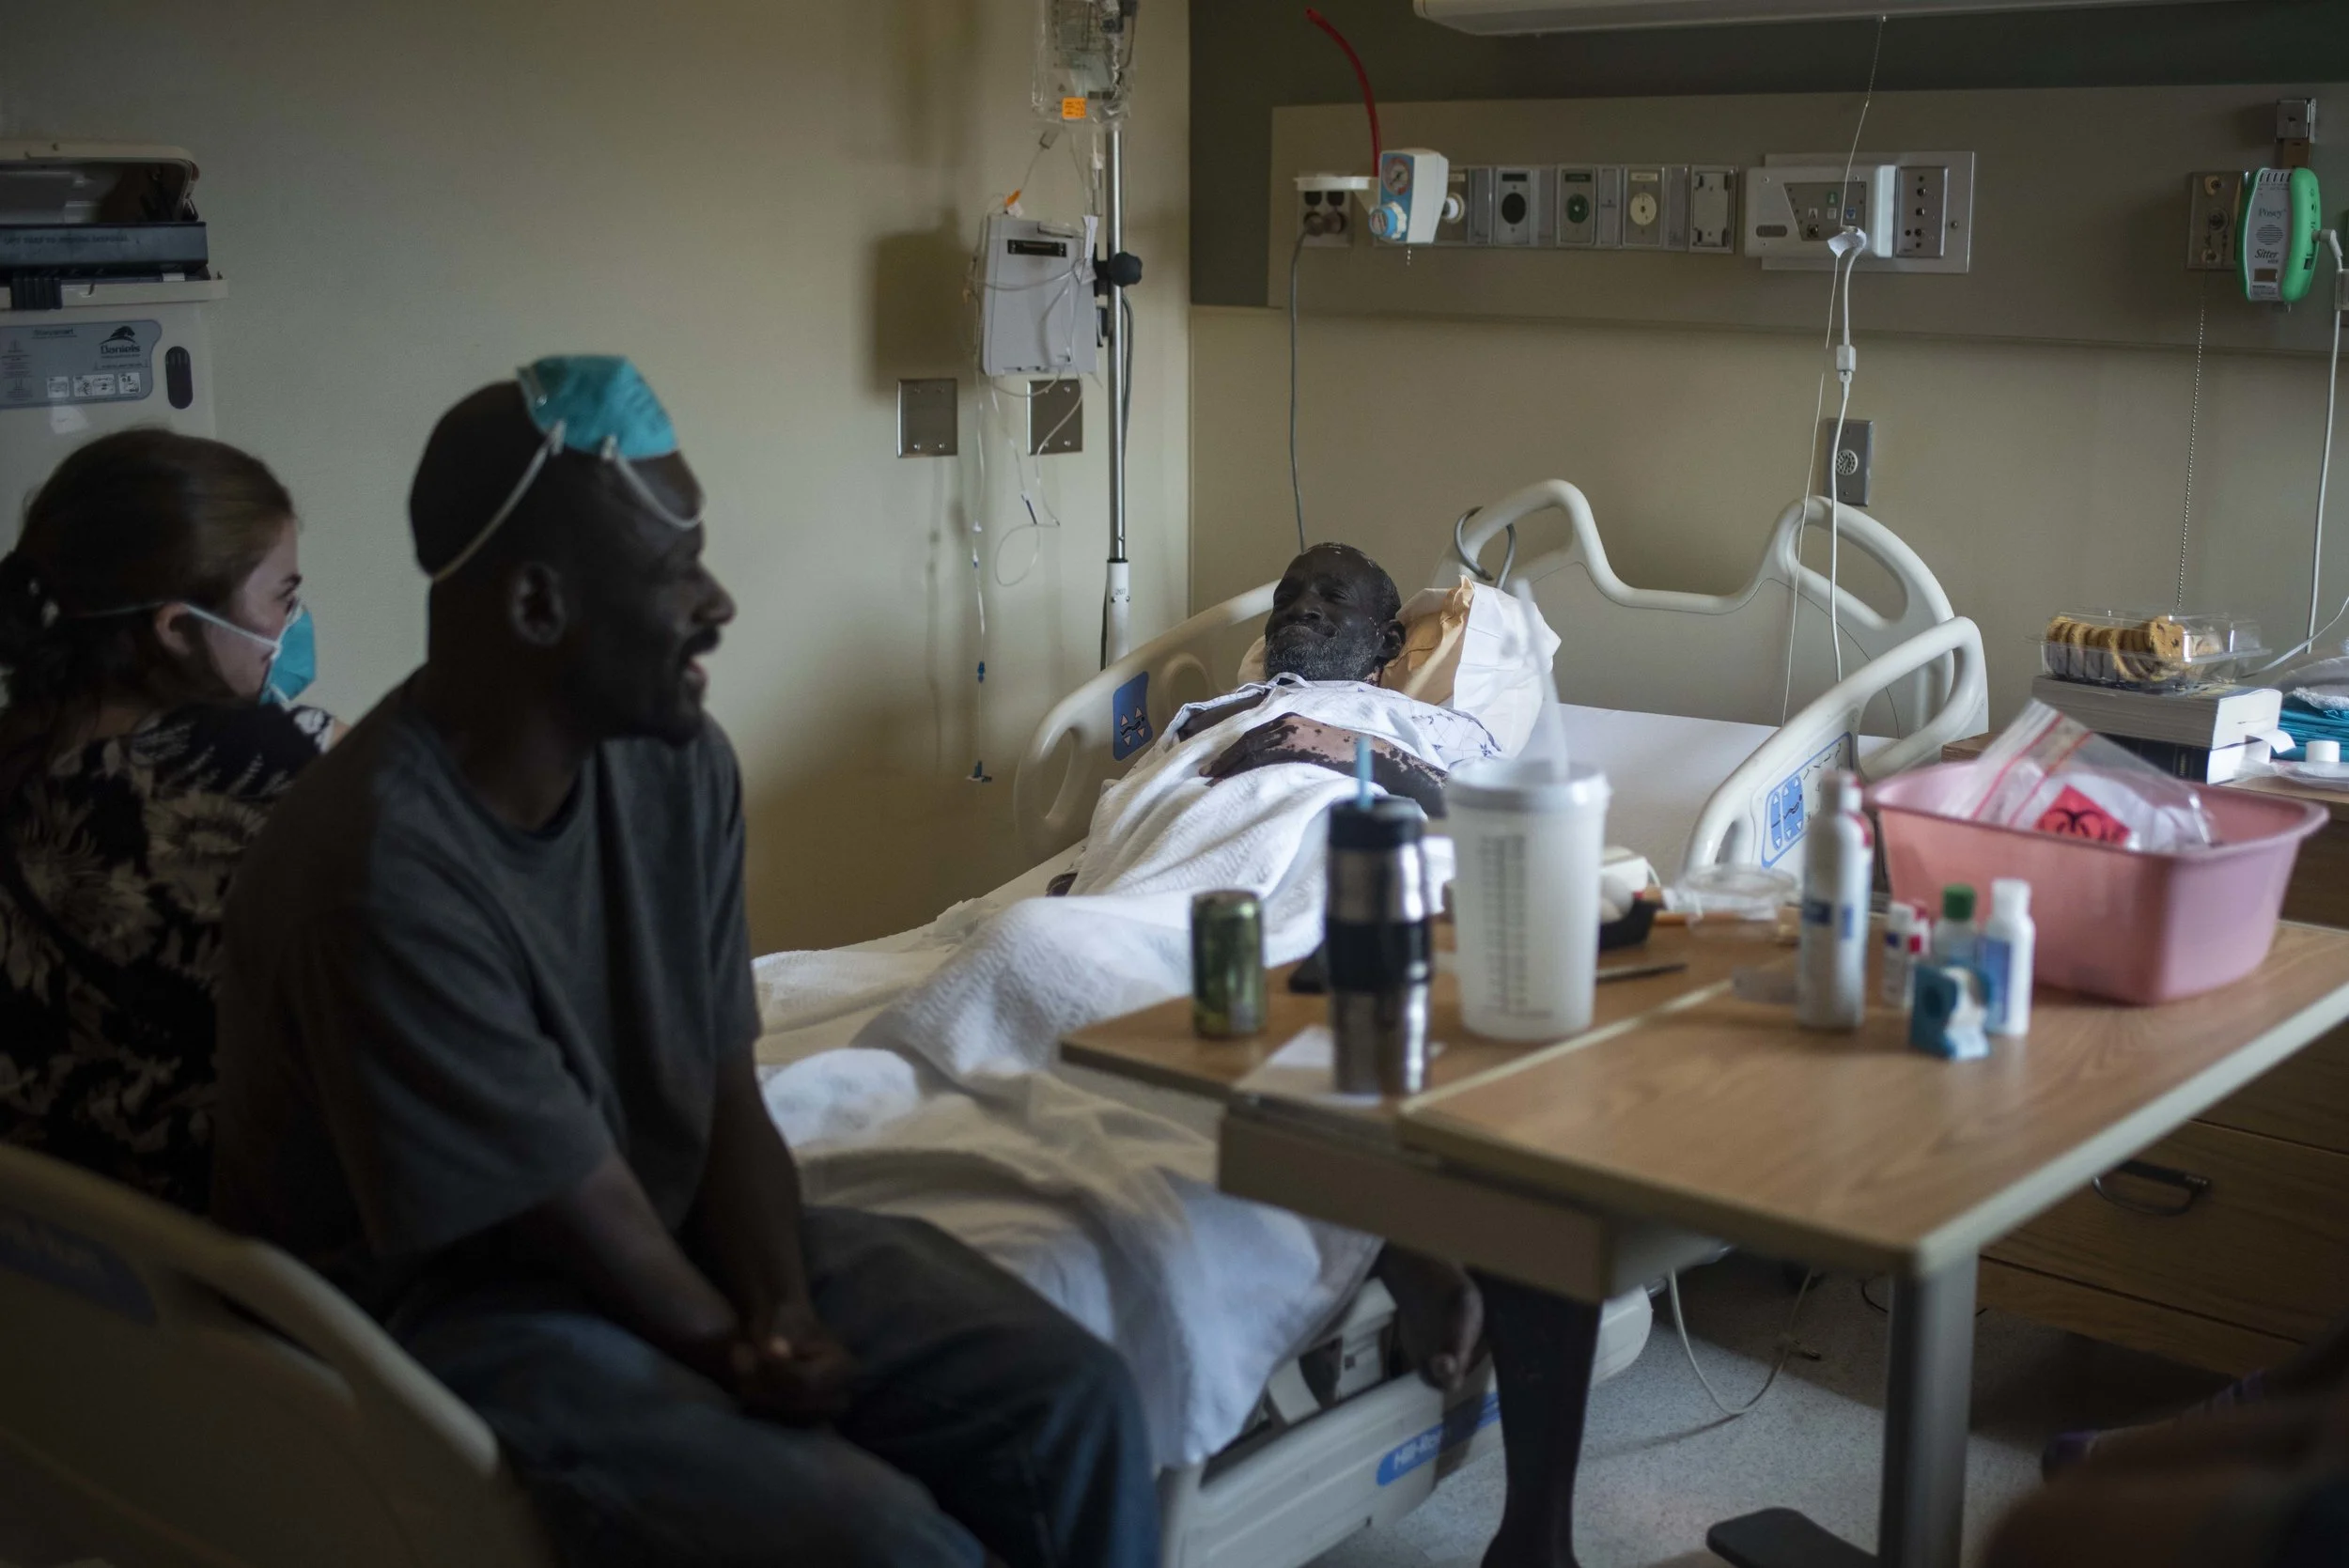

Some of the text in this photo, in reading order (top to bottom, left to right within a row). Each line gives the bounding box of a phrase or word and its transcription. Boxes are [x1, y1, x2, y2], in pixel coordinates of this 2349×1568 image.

[2259, 208, 2281, 219] Posey
[2255, 248, 2279, 258] Sitter
[101, 345, 141, 355] Daniels
